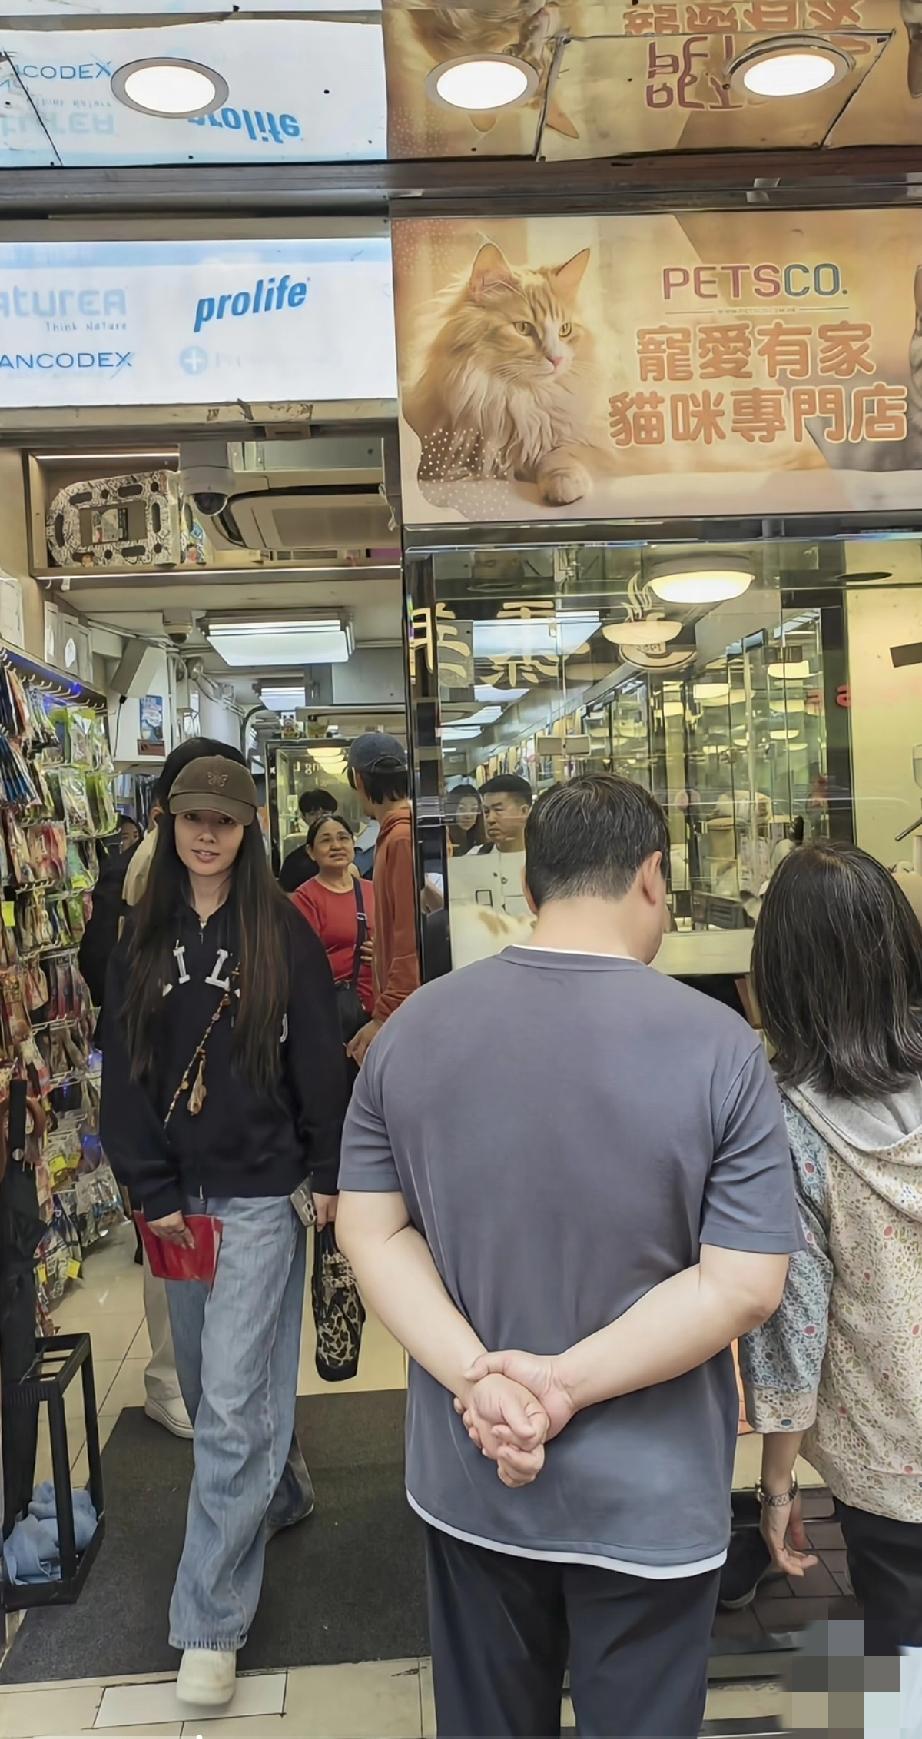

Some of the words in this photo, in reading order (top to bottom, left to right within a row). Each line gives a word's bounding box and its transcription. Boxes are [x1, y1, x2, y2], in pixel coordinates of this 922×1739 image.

[194, 275, 307, 332] prolife
[664, 263, 848, 299] PETSCO.
[637, 321, 876, 381] 寵愛有家
[609, 383, 907, 445] 貓咪專門店
